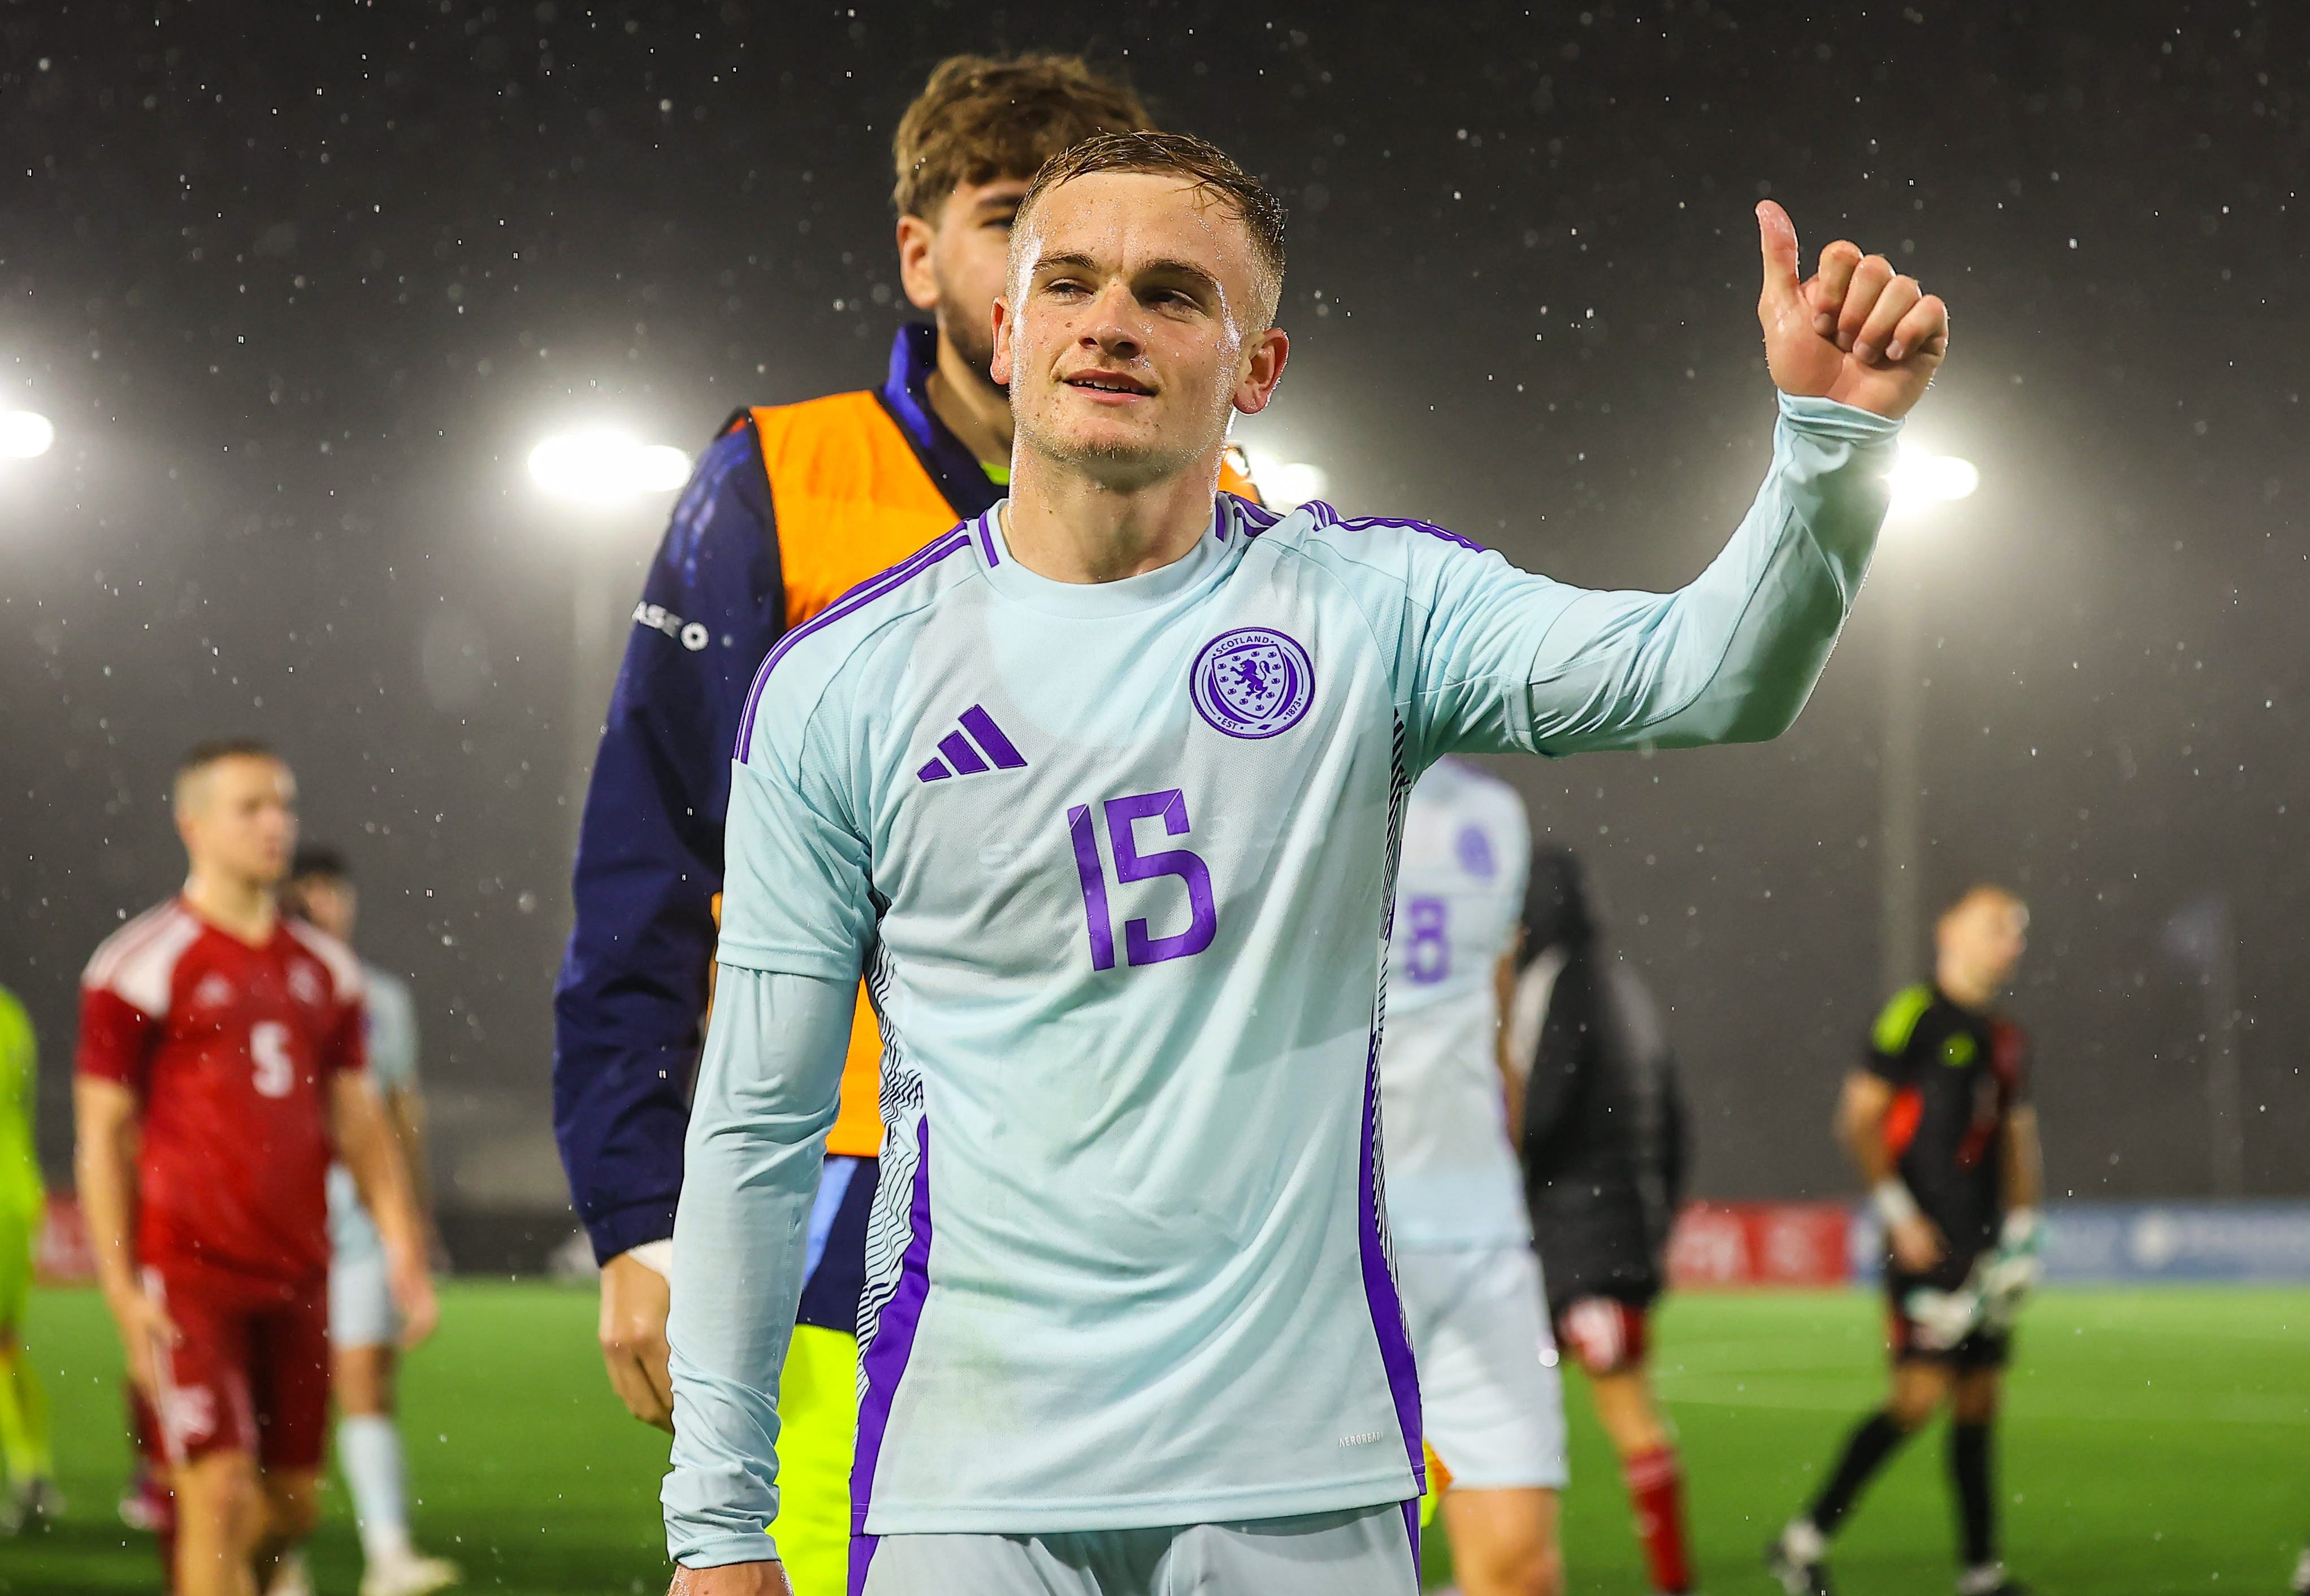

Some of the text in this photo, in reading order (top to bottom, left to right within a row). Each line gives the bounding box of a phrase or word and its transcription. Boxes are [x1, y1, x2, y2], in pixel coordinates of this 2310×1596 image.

[1216, 636, 1269, 654] SCOTLAND
[1285, 700, 1302, 718] 1873
[1221, 718, 1238, 730] EST
[1067, 788, 1216, 972] 15
[249, 1022, 294, 1098] 5
